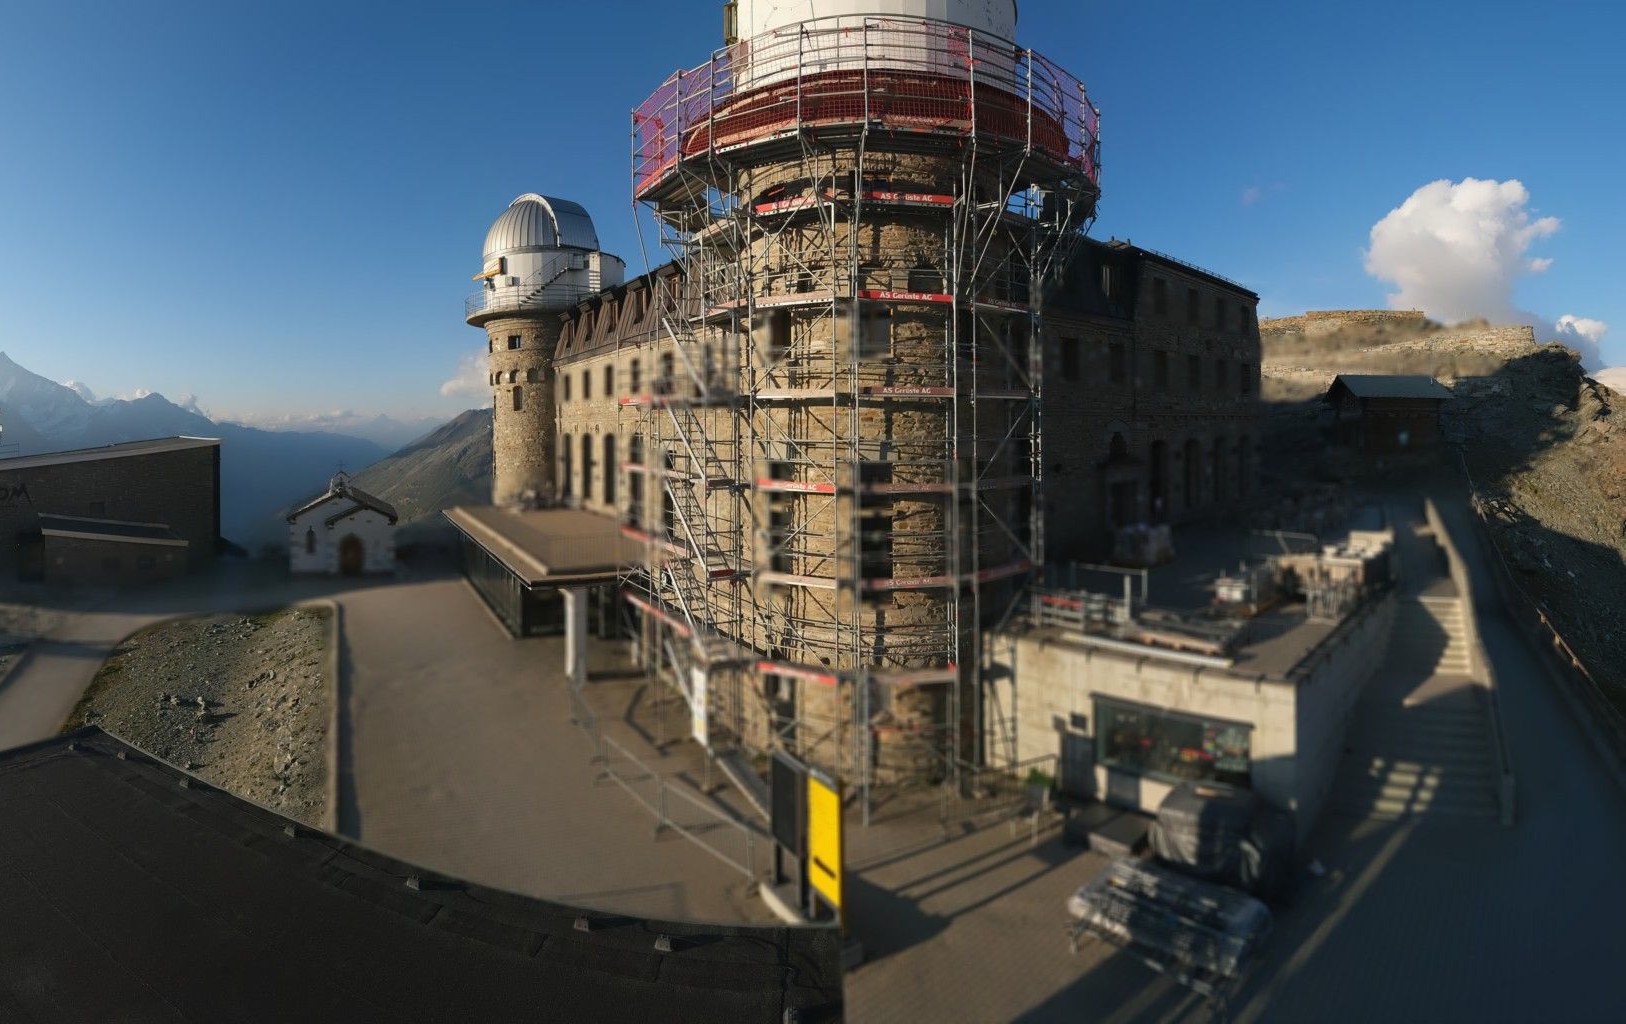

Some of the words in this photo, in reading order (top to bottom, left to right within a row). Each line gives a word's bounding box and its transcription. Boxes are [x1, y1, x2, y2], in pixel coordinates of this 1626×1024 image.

[922, 194, 933, 202] AG
[880, 291, 891, 299] AS
[892, 292, 920, 300] Gerüste
[921, 293, 933, 301] AG
